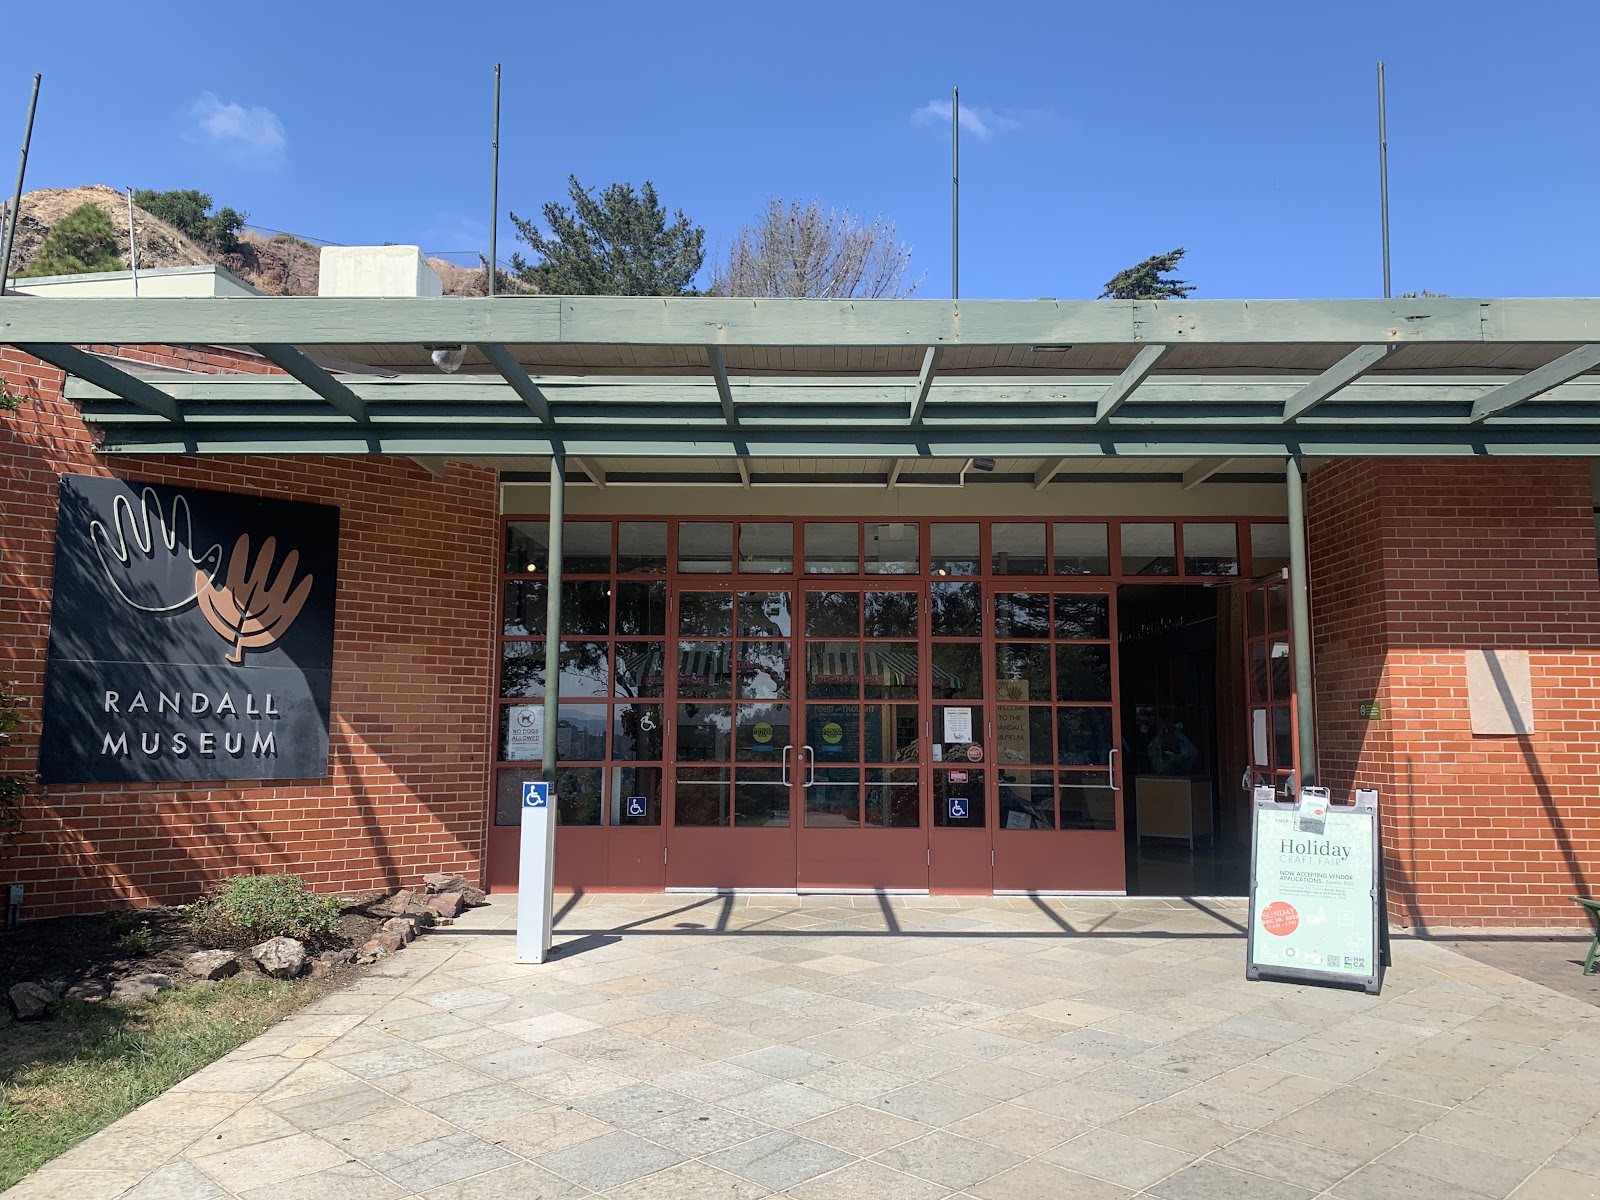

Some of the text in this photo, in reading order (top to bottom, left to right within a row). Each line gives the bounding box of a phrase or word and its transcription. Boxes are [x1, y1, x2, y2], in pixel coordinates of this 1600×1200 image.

[104, 690, 279, 714] RANDALL
[101, 731, 276, 754] MUSEUM
[1280, 838, 1351, 861] Holiday
[1280, 854, 1341, 866] CRAFT FAIR
[1262, 908, 1294, 919] SUNDAY
